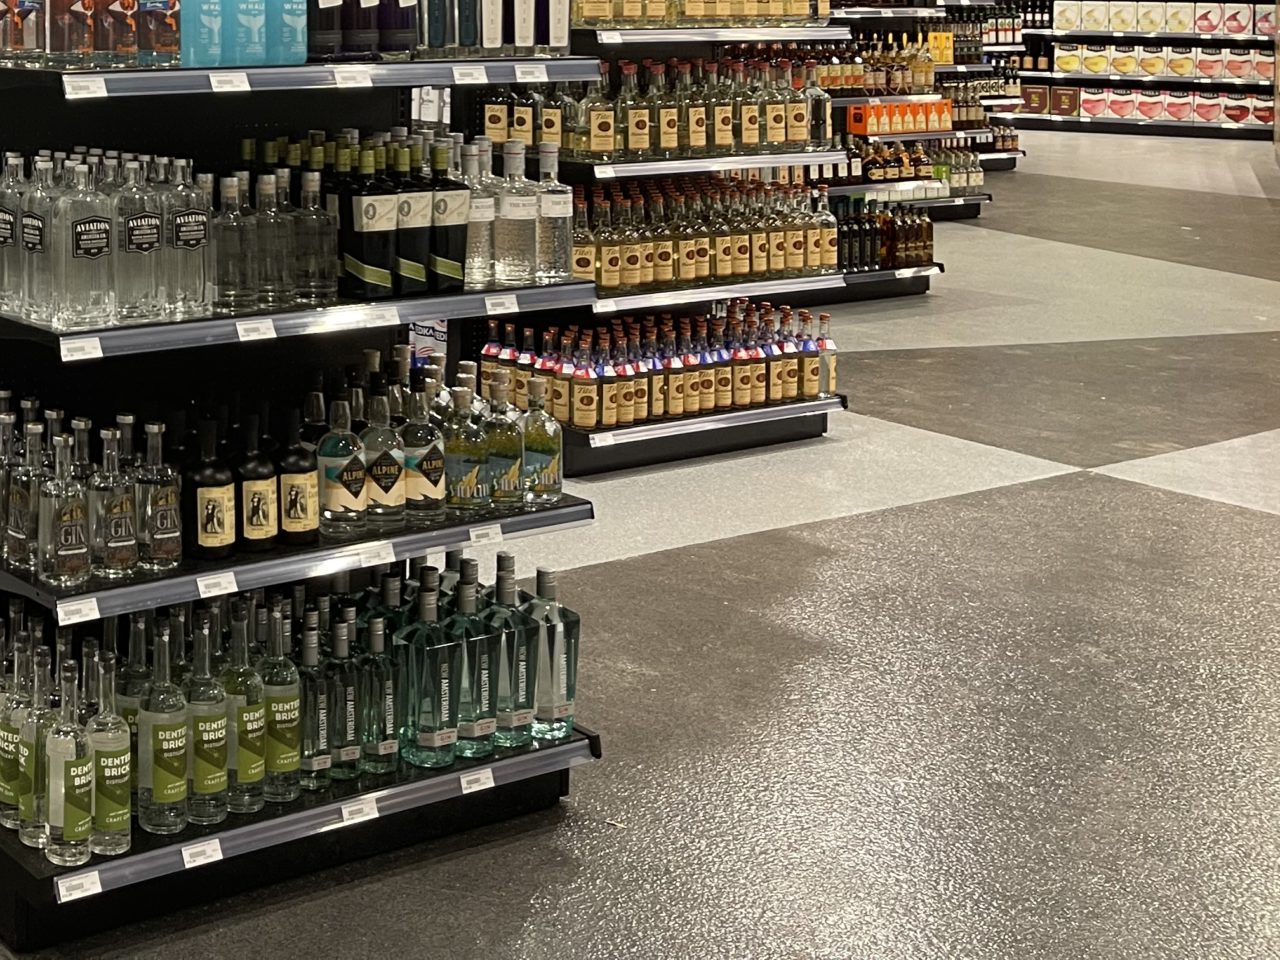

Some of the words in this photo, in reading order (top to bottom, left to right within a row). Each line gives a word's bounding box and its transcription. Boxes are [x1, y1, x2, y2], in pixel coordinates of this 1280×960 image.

[128, 218, 160, 227] AVIATION
[176, 214, 207, 224] AVIATION
[76, 222, 110, 232] AVIATION
[372, 465, 399, 475] ALPINE
[481, 669, 489, 711] AMSTERDAM
[441, 679, 449, 721] AMSTERDAM
[276, 710, 299, 721] BRICK
[385, 695, 394, 735] AMSTERDAM
[347, 701, 355, 741] AMSTERDAM
[319, 709, 327, 750] AMSTERDAM
[202, 730, 226, 741] BRICK
[162, 738, 186, 749] BRICK
[104, 763, 130, 776] BRICK
